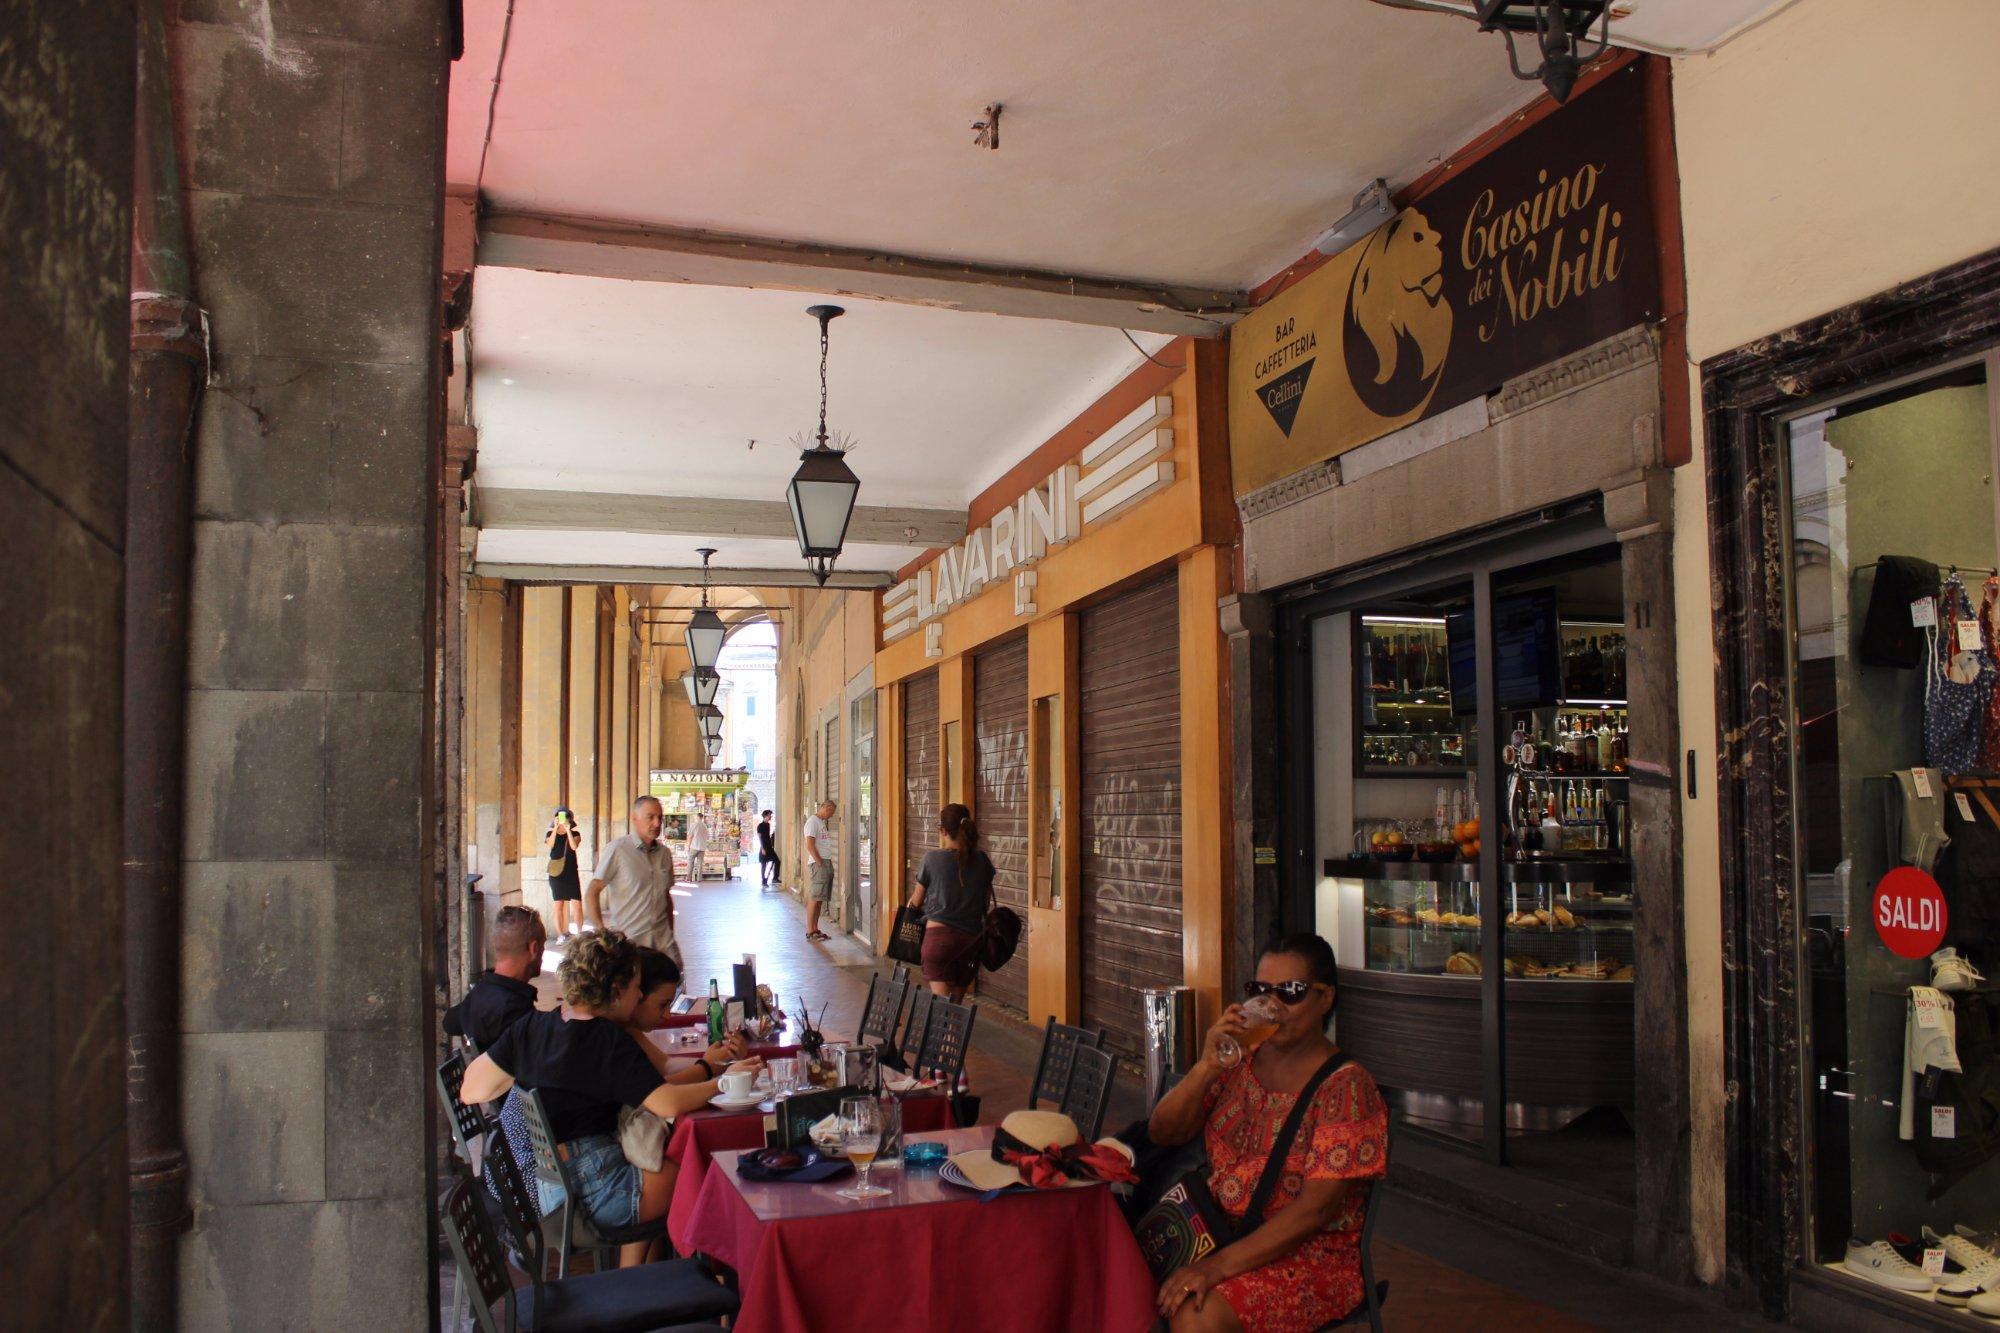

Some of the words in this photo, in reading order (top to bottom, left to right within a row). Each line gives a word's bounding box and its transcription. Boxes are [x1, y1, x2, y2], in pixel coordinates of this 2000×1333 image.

[1461, 163, 1606, 270] Casino
[1468, 268, 1493, 306] dei
[1478, 202, 1626, 343] Nobili
[1275, 317, 1295, 343] BAR
[1254, 331, 1317, 380] CAFFETTERIA
[1267, 376, 1303, 409] Cellini
[670, 773, 734, 783] NAZIONE
[1879, 894, 1940, 932] SALDI
[1915, 1000, 1936, 1008] 30%
